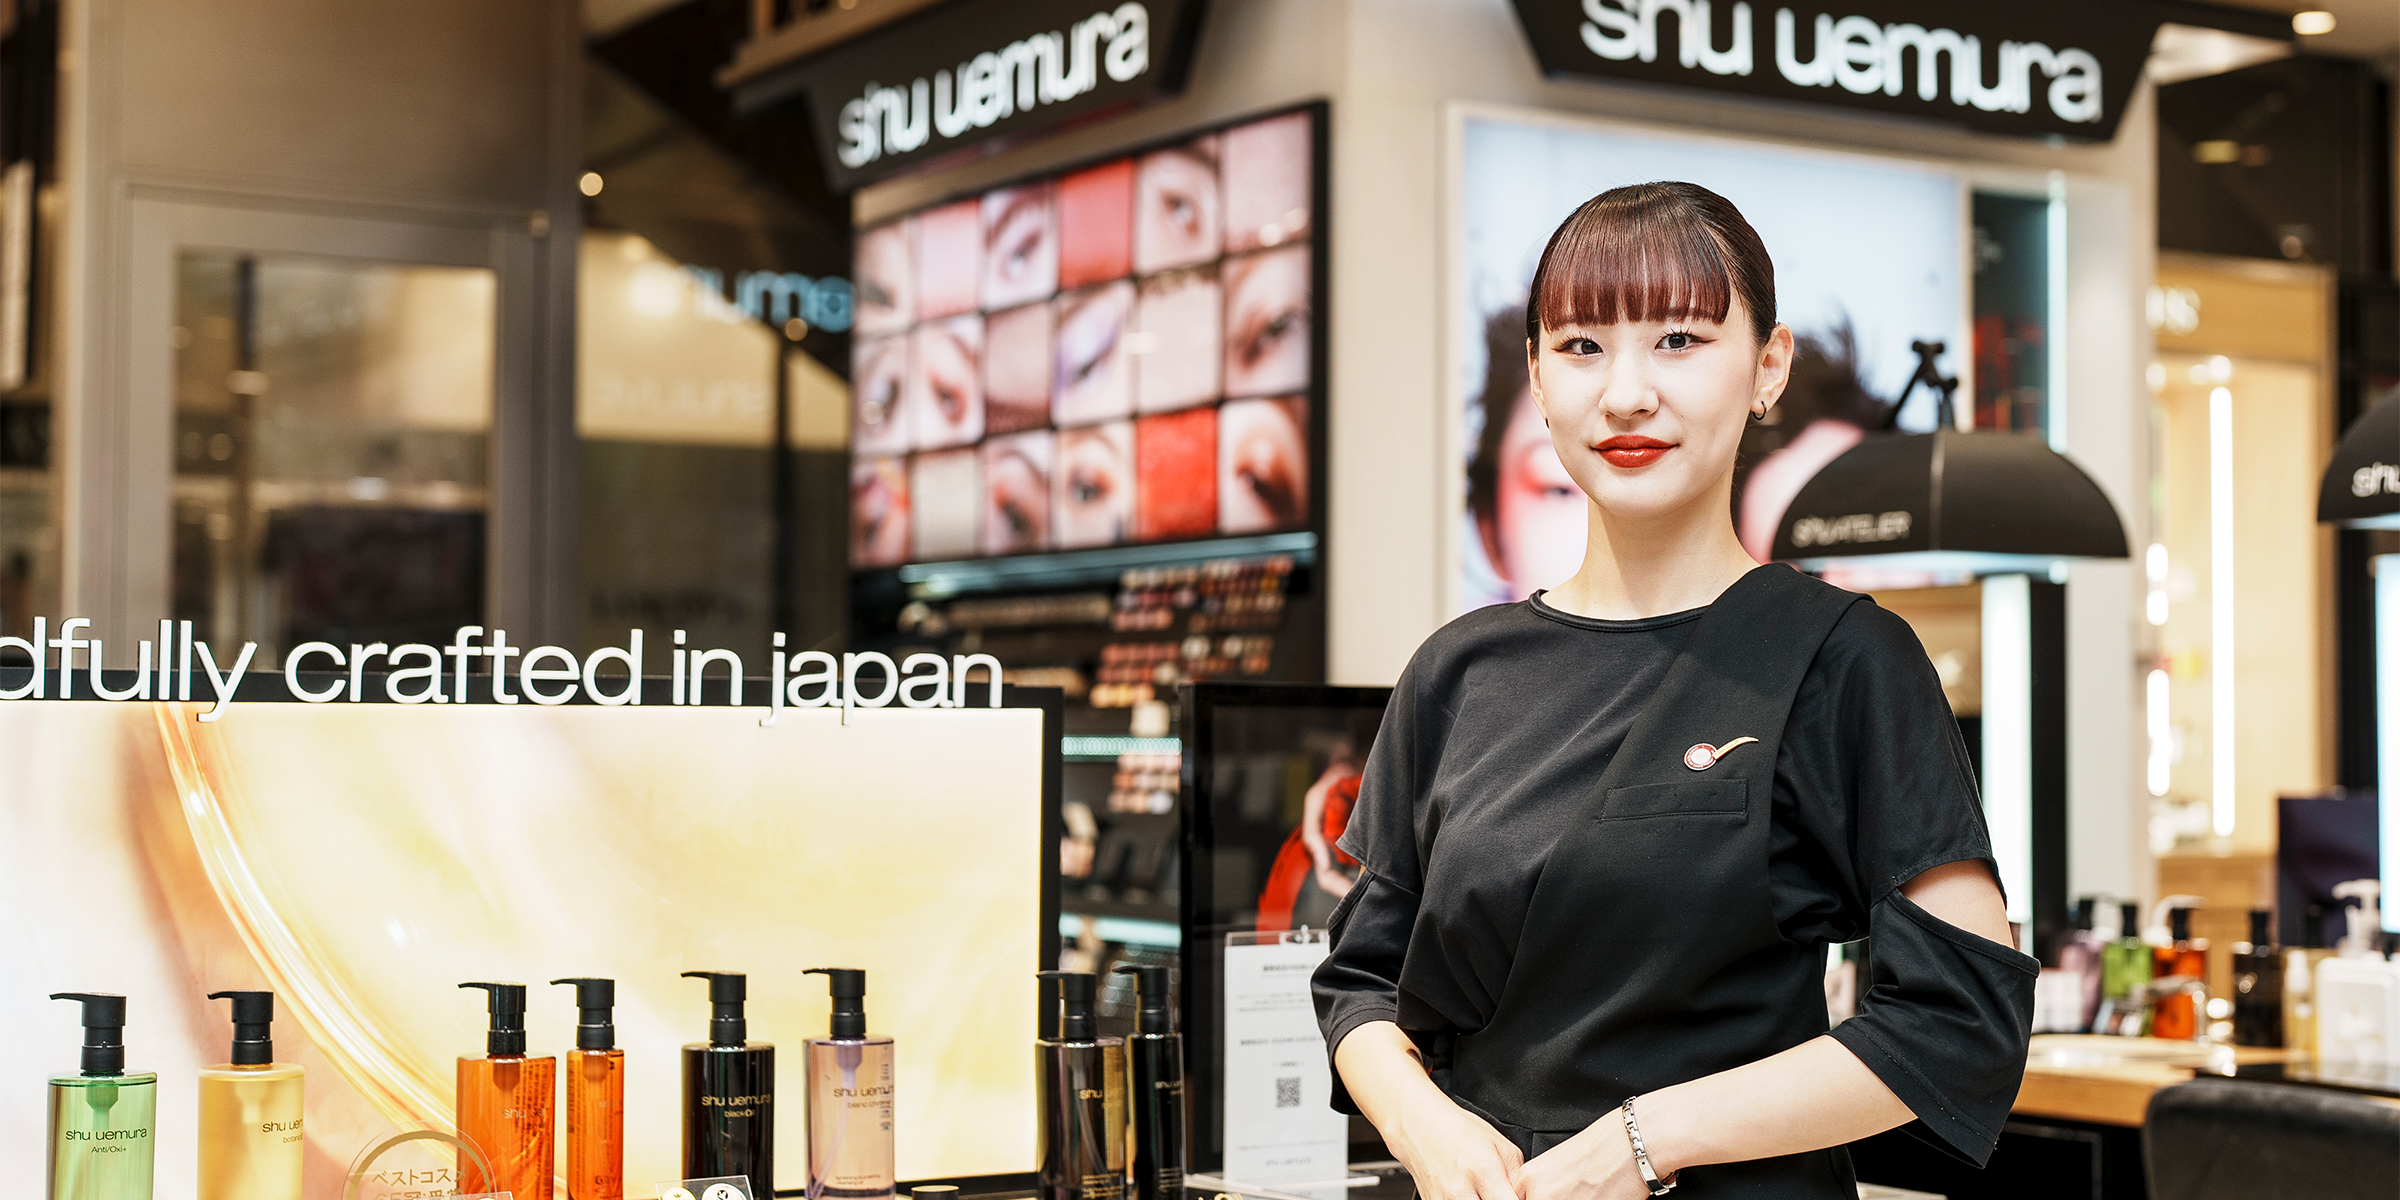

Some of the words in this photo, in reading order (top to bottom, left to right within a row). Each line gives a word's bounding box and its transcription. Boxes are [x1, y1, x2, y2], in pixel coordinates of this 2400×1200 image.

[1579, 0, 1753, 76] shu
[1774, 6, 2103, 123] uemura
[837, 79, 931, 169] shu
[934, 1, 1149, 138] uemura
[0, 616, 258, 722] dfully
[284, 625, 643, 706] crafted
[672, 629, 743, 706] in
[758, 631, 1003, 726] japan
[834, 1086, 858, 1098] shu
[701, 1095, 726, 1107] shu
[728, 1094, 771, 1107] uemura
[502, 1108, 527, 1119] shu
[262, 1121, 286, 1133] shu
[65, 1129, 91, 1141] shu
[95, 1127, 147, 1141] uemura
[91, 1145, 127, 1154] Anti/Oxi+
[371, 1165, 468, 1187] ベストコスメ
